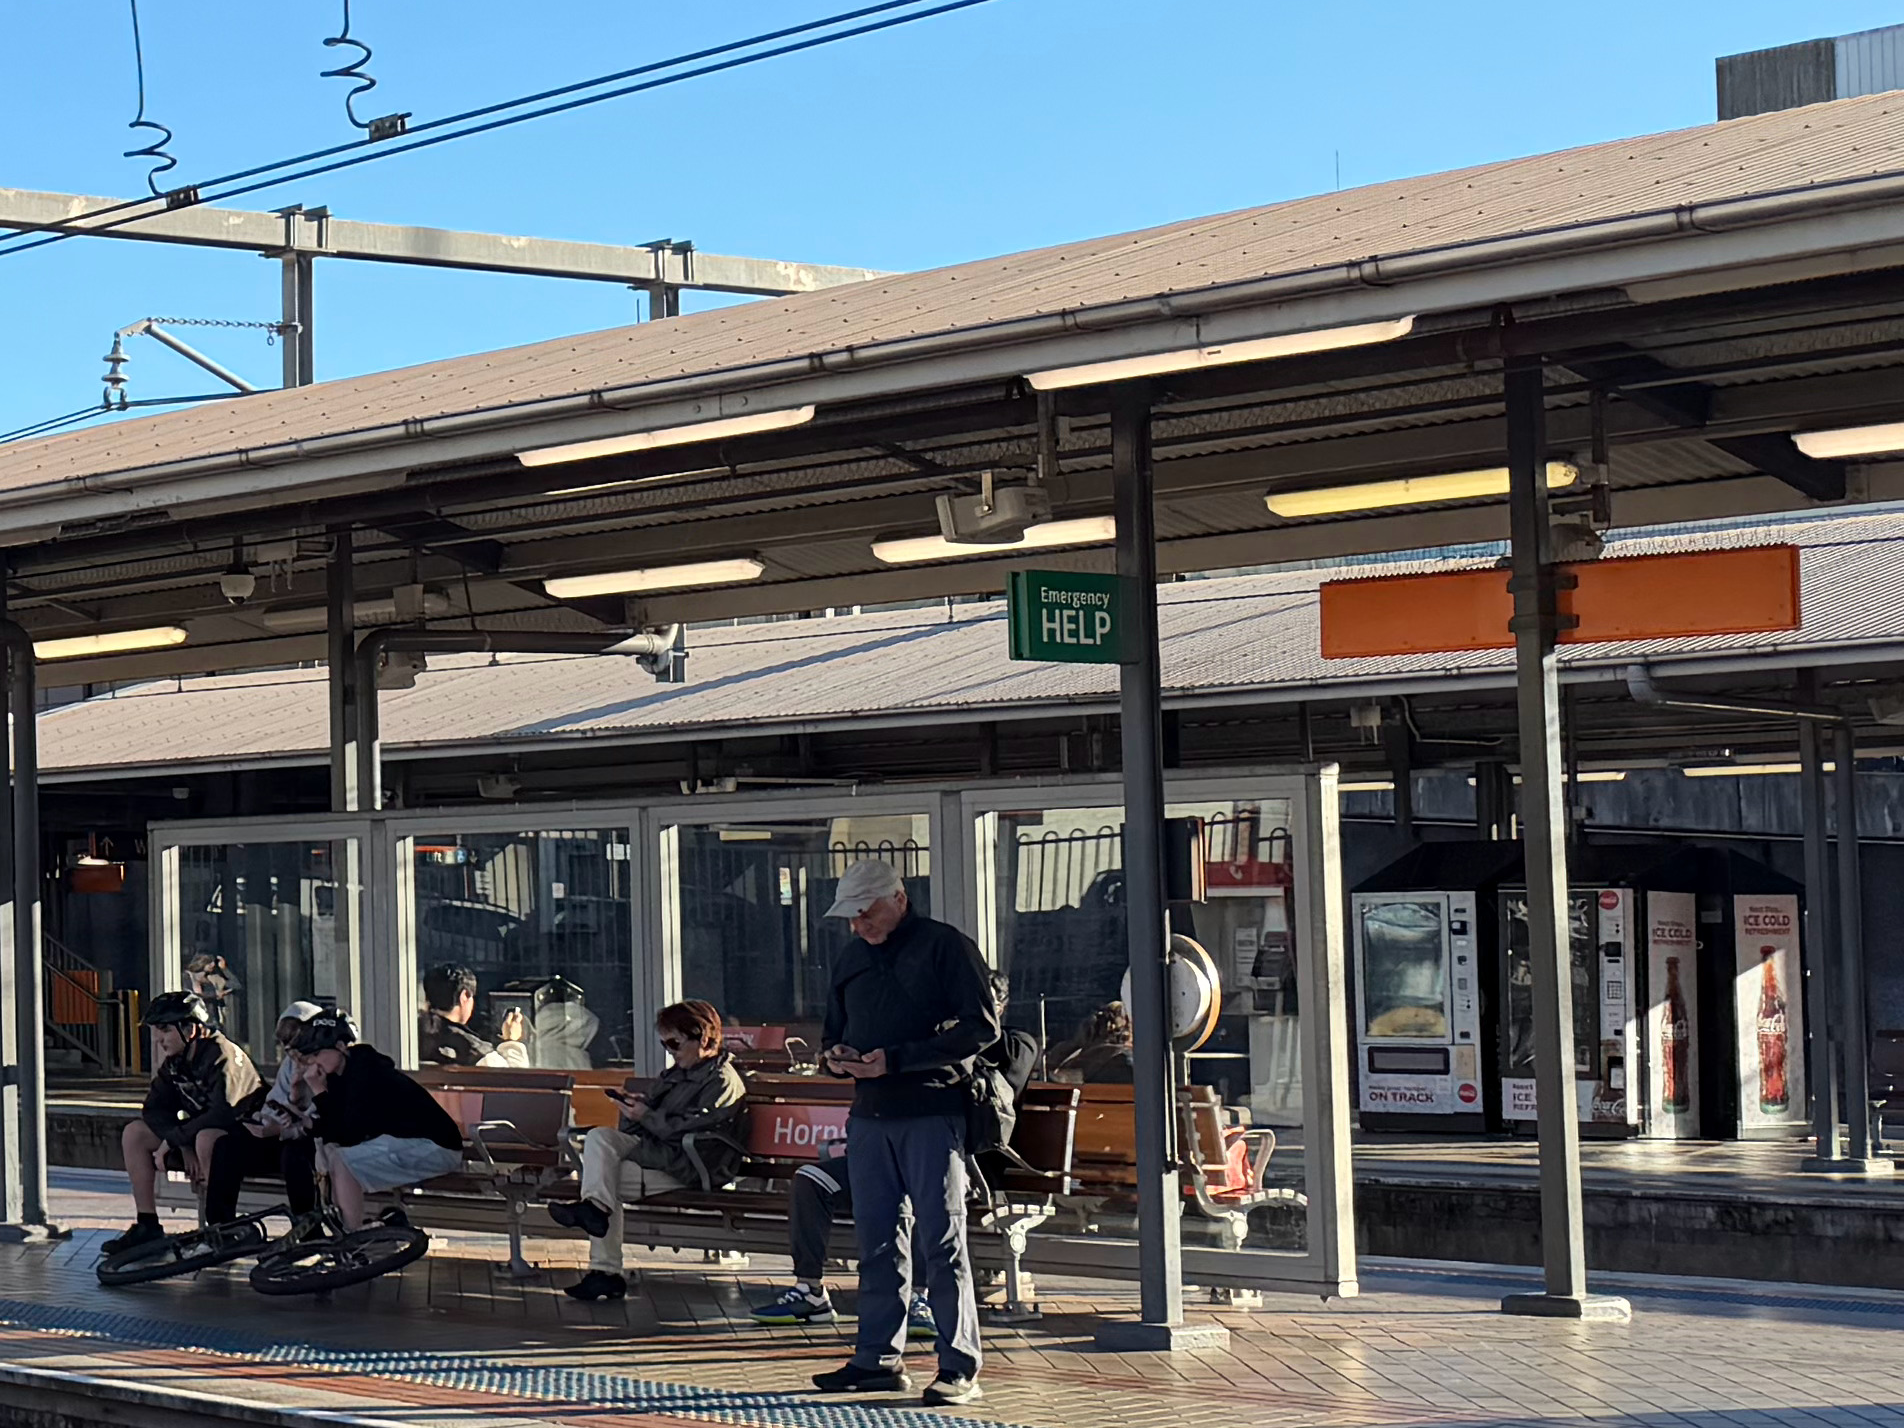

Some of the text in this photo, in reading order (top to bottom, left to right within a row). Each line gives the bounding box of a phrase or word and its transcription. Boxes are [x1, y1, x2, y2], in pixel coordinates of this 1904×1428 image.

[1040, 586, 1110, 609] Emergency
[1042, 608, 1111, 645] HELP
[1763, 915, 1790, 926] COLD
[1369, 1092, 1434, 1104] ON TRACK
[774, 1117, 847, 1145] Horn
